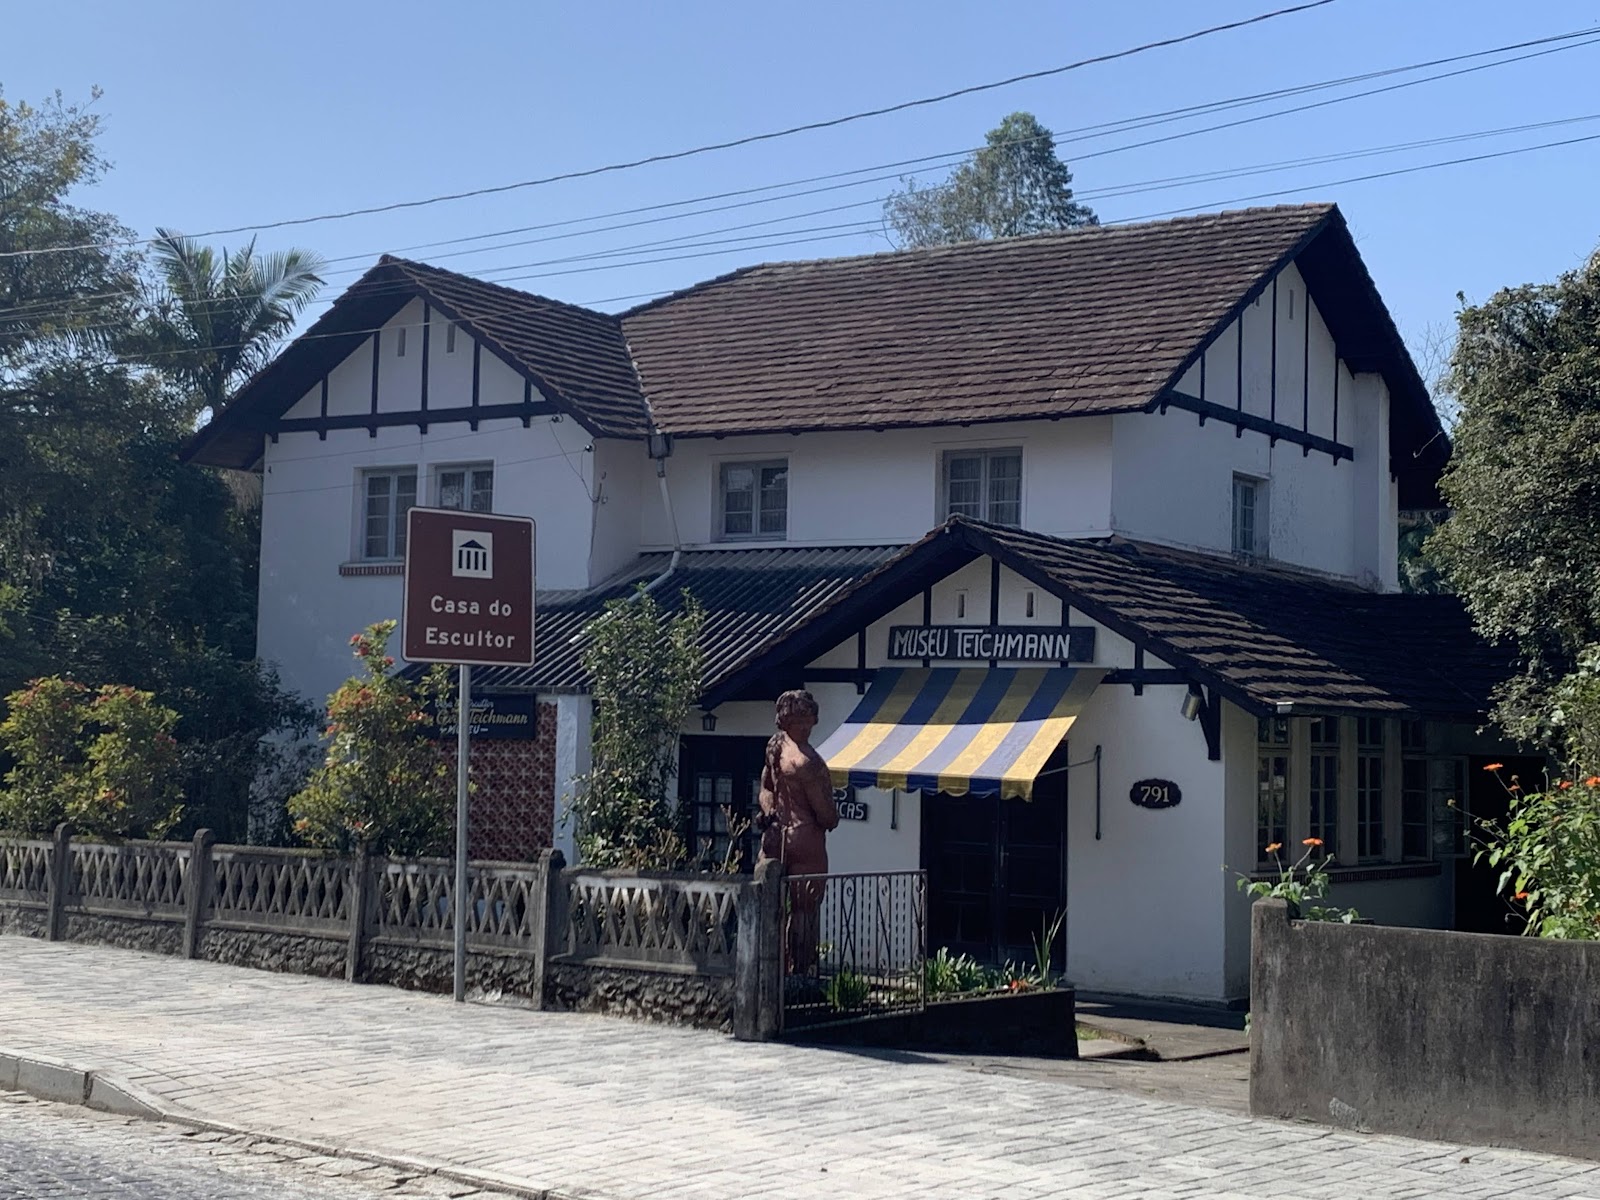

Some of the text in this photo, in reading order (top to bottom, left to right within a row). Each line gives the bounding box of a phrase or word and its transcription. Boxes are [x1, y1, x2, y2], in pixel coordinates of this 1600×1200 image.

[430, 595, 512, 617] Casa do
[425, 627, 515, 649] Escultor
[894, 628, 1070, 659] MUSEU TEICHMANN
[1140, 786, 1170, 803] 791
